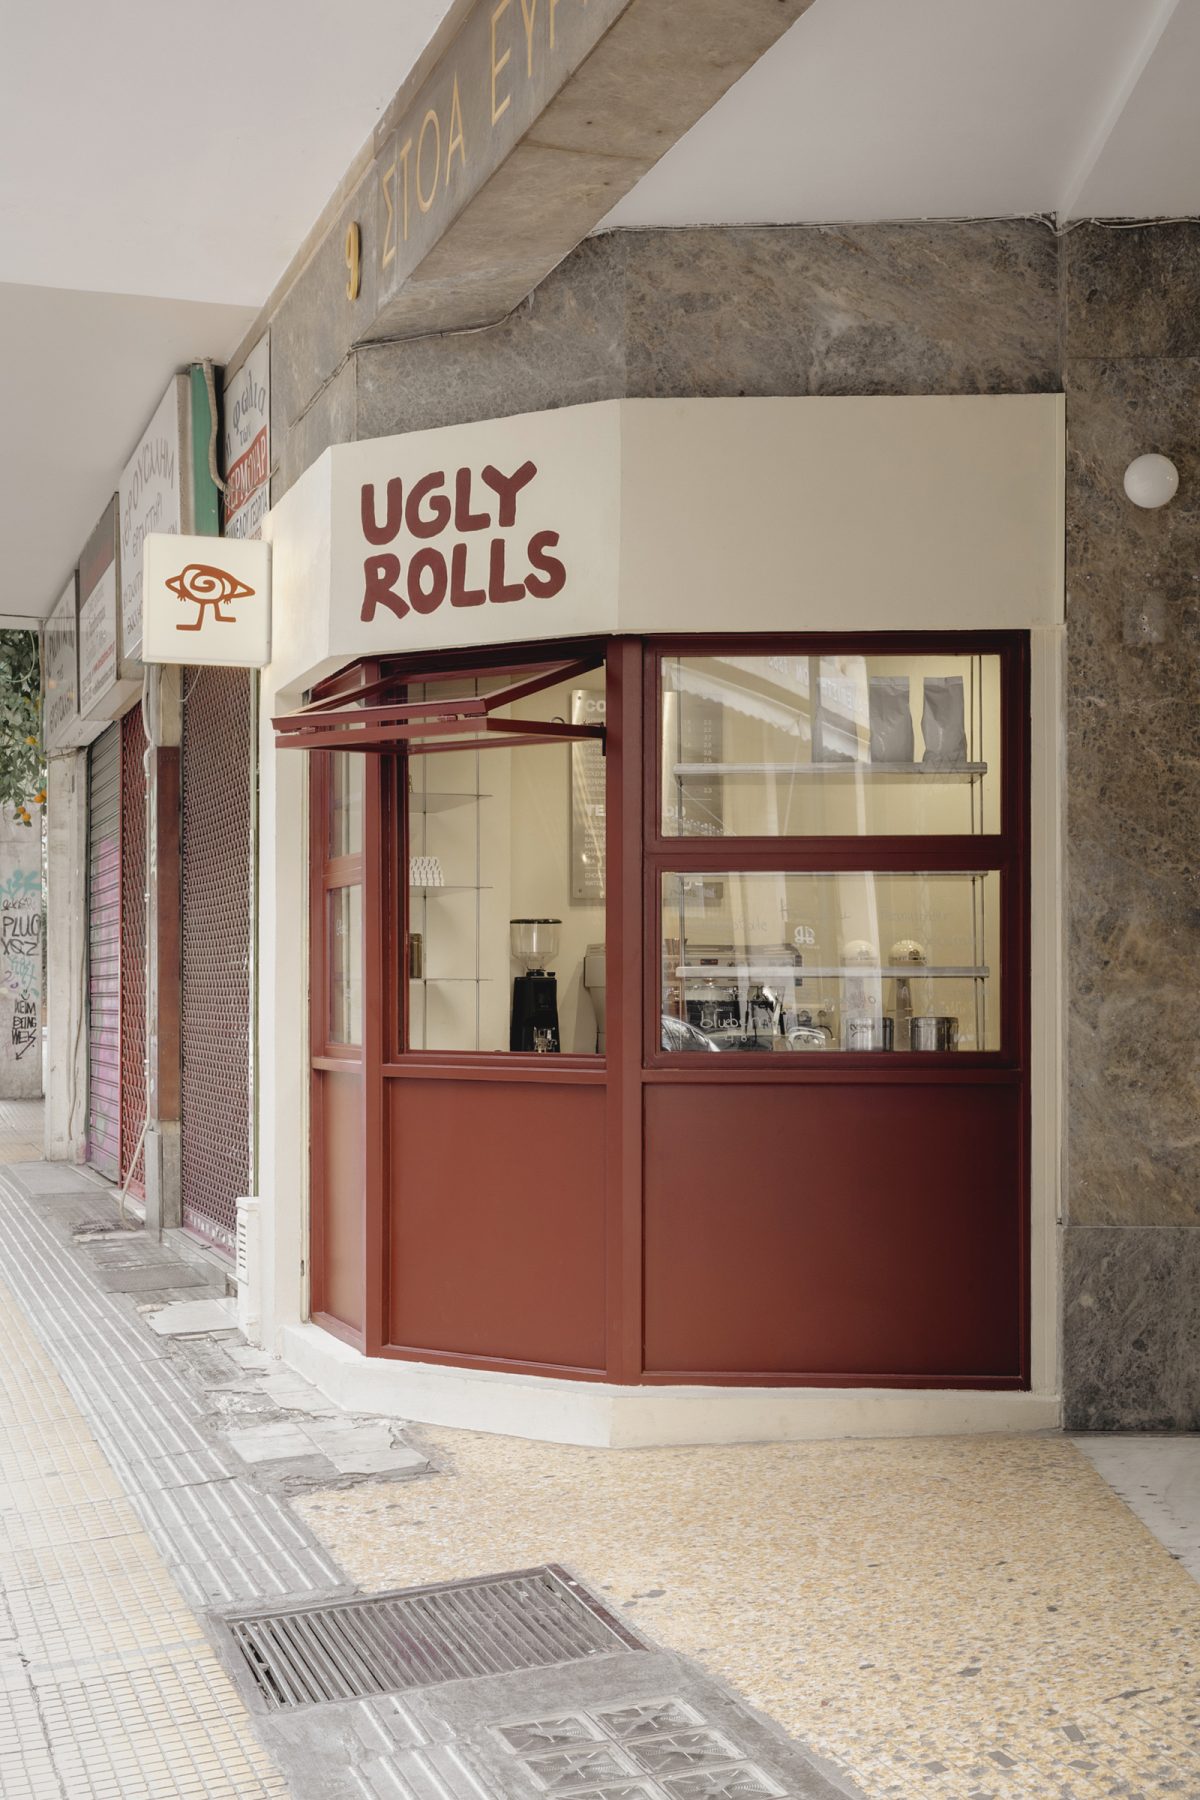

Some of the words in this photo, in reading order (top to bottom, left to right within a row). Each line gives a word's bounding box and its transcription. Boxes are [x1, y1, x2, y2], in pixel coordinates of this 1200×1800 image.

[382, 73, 466, 270] ΣΤΟΑ
[345, 221, 361, 302] 9
[361, 460, 537, 545] UGLY
[360, 530, 566, 622] ROLLS
